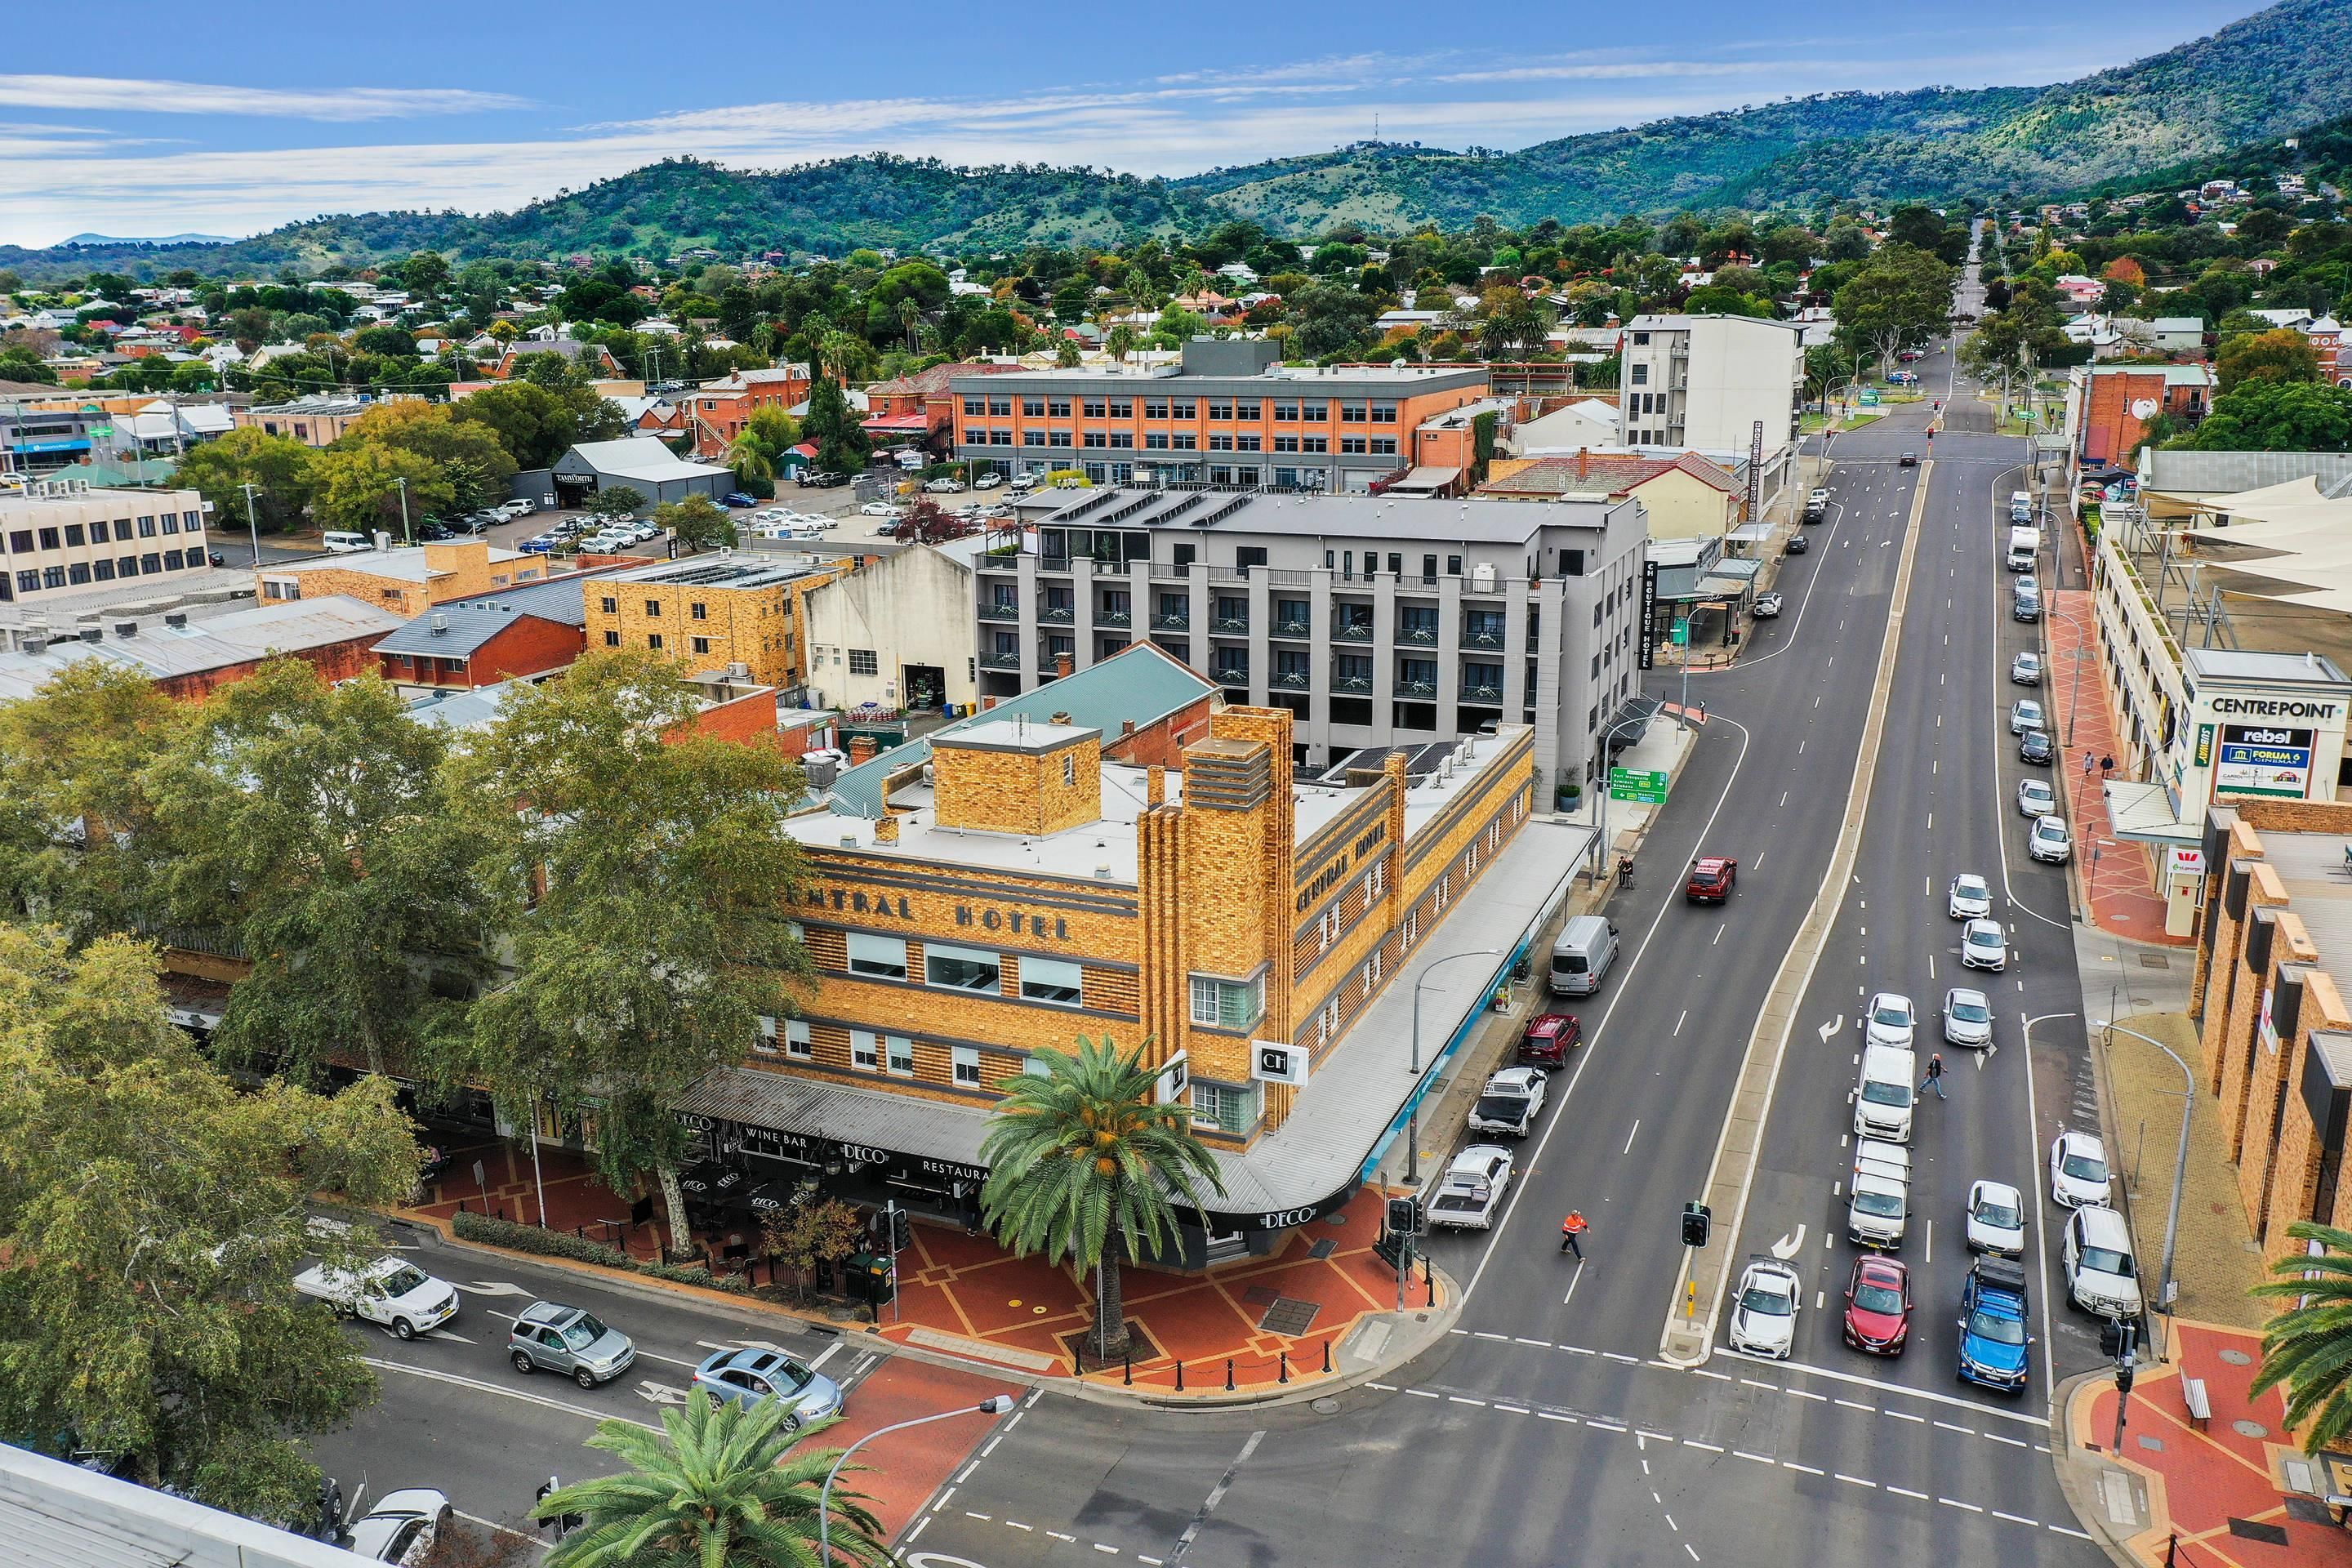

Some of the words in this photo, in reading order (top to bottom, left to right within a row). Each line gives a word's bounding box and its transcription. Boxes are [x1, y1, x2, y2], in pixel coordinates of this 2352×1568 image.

[1647, 564, 1654, 577] CH
[1644, 581, 1653, 632] BOUTIQUE
[2212, 697, 2336, 719] CENTREPOINT
[2198, 727, 2211, 764] SUBWAY
[2243, 729, 2292, 744] rebel
[2252, 751, 2290, 760] FORUM
[786, 885, 912, 920] NTRAL
[956, 906, 1071, 940] HOTEL
[1263, 1054, 1286, 1070] CH
[1173, 1064, 1183, 1085] CH
[746, 1127, 778, 1143] WINE
[784, 1134, 807, 1148] BAR
[844, 1143, 885, 1164] DECO
[923, 1160, 990, 1181] RESTAURA
[1266, 1207, 1312, 1229] DECO
